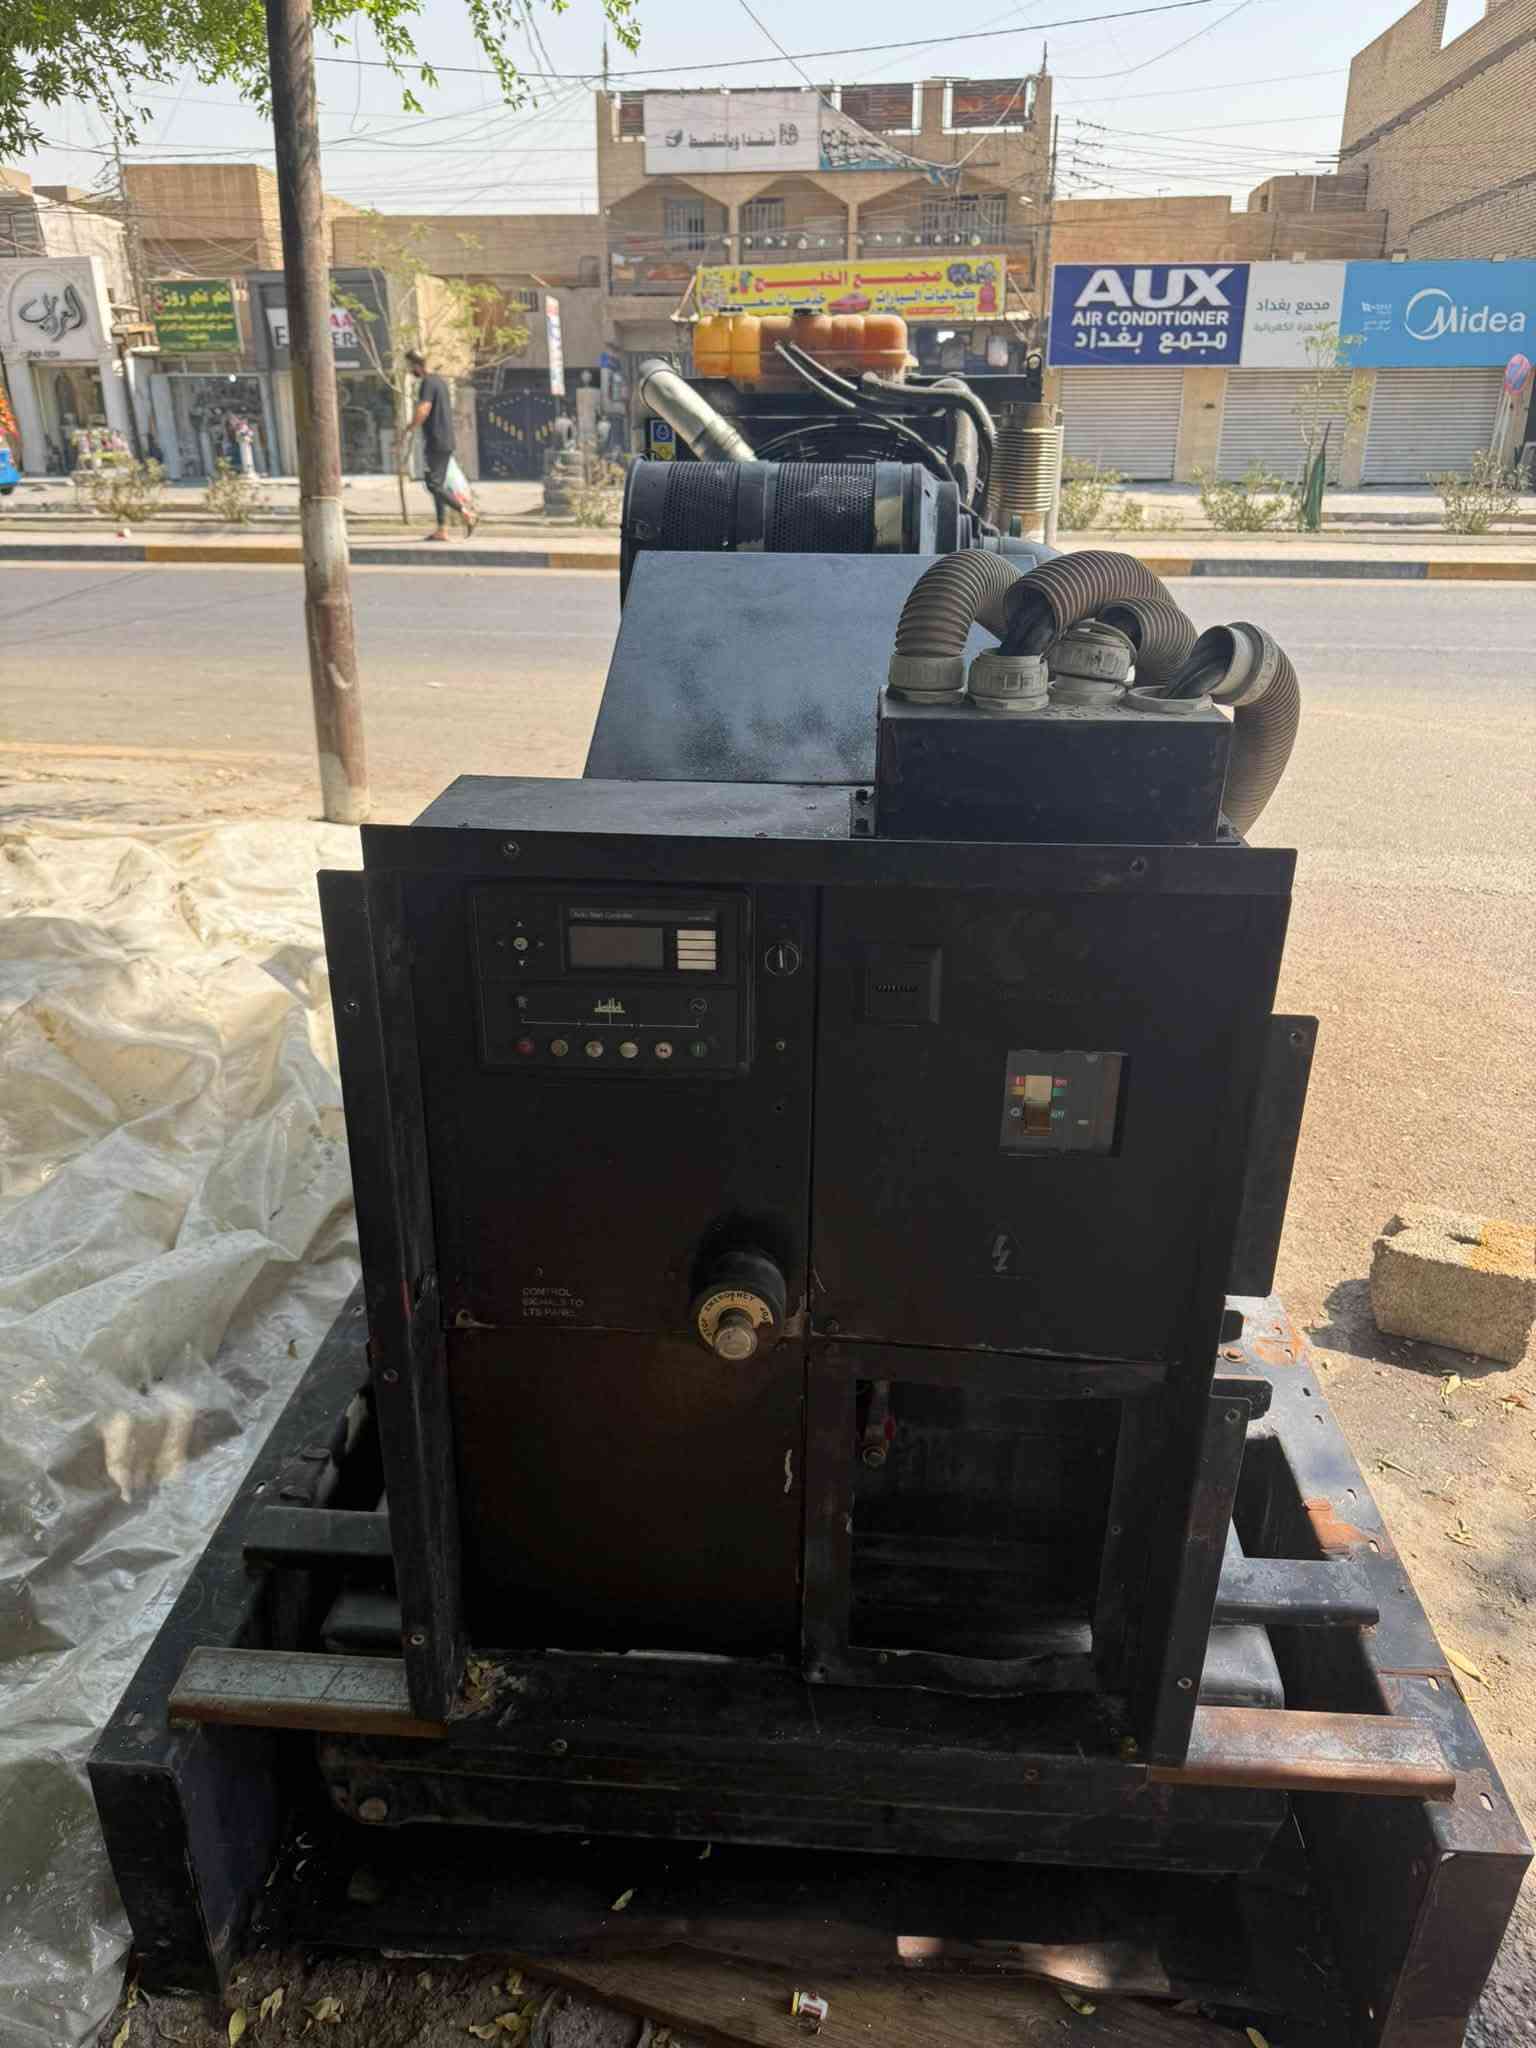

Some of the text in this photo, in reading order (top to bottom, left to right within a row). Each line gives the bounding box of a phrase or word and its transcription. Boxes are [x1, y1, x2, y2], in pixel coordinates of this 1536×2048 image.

[754, 270, 943, 293] مجمع الخليج
[1074, 267, 1236, 307] AUX
[1071, 309, 1230, 327] AIR CONDITIONER
[1255, 299, 1331, 316] مجمع بغداد
[1417, 301, 1527, 335] Midea
[1073, 329, 1228, 354] مجمع بغداد
[522, 1287, 573, 1297] CONTROL
